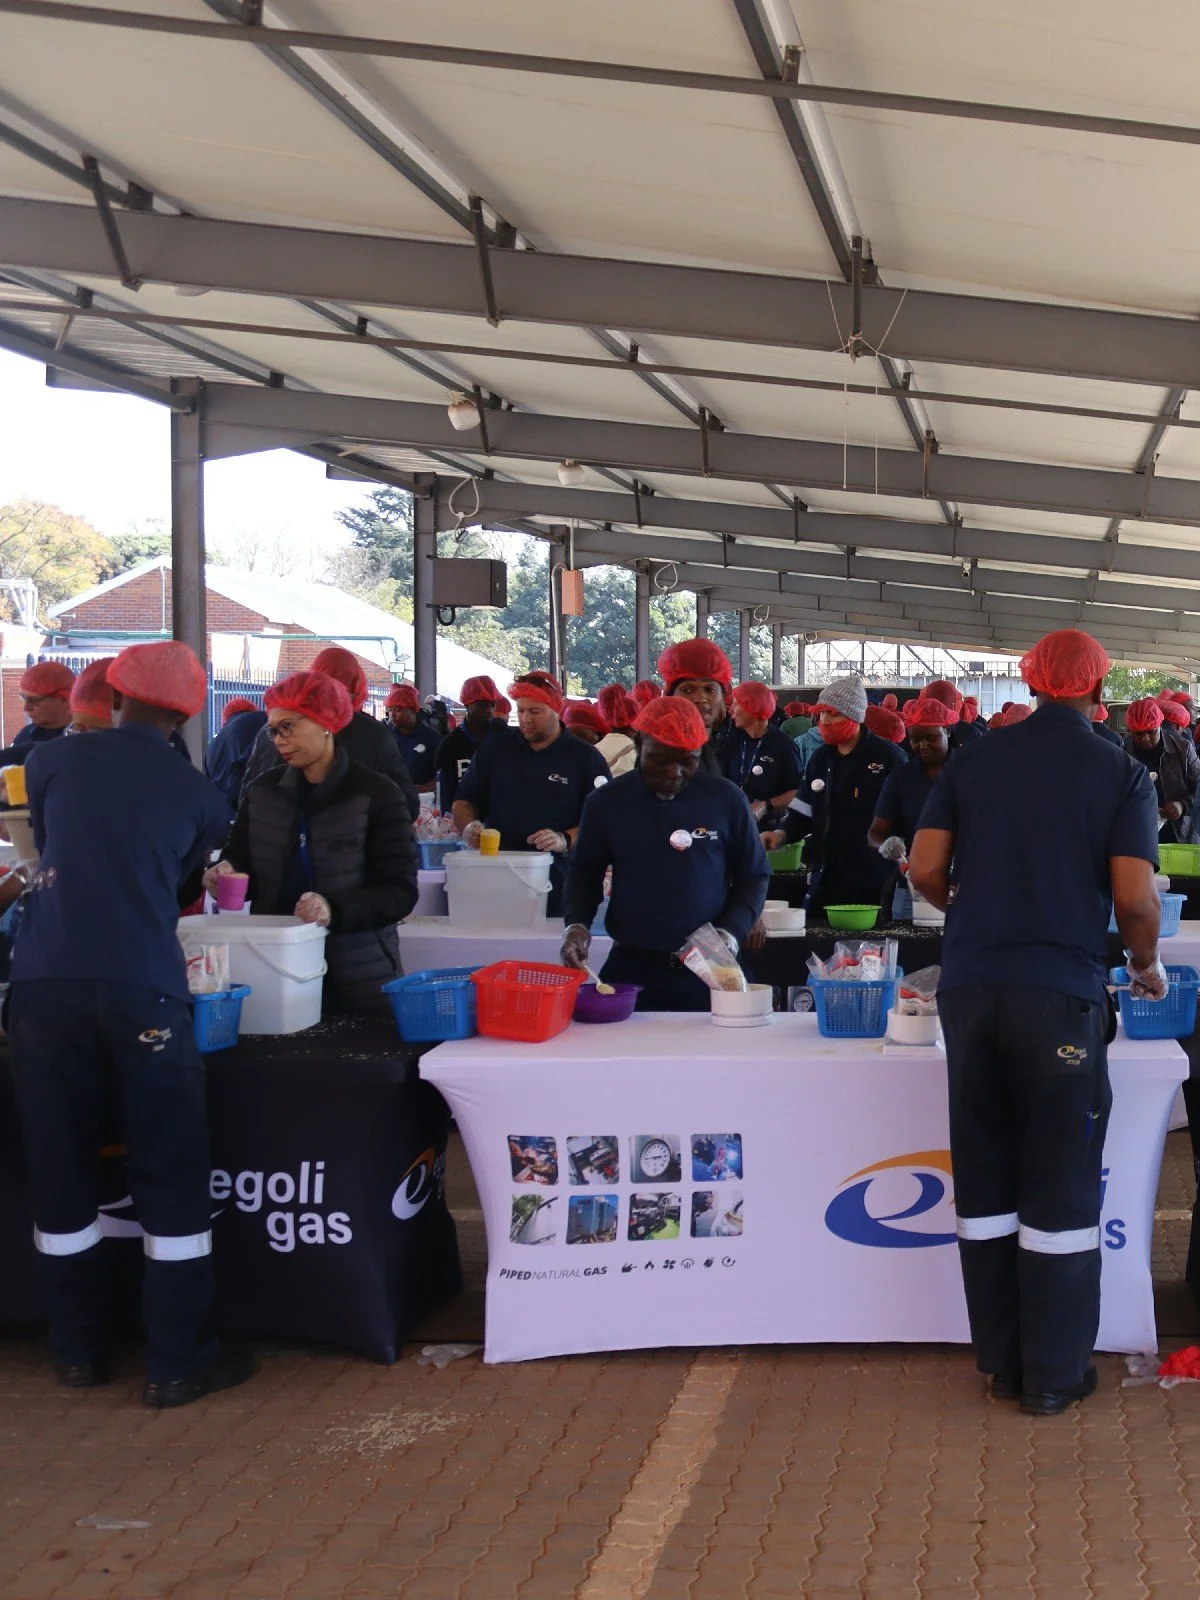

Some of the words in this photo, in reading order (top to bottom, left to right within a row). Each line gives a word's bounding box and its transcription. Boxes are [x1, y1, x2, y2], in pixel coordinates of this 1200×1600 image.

[209, 1161, 325, 1212] egoli
[266, 1211, 352, 1252] gas
[500, 1268, 531, 1280] PIPED
[532, 1268, 581, 1280] NATURAL
[583, 1266, 608, 1276] GAS
